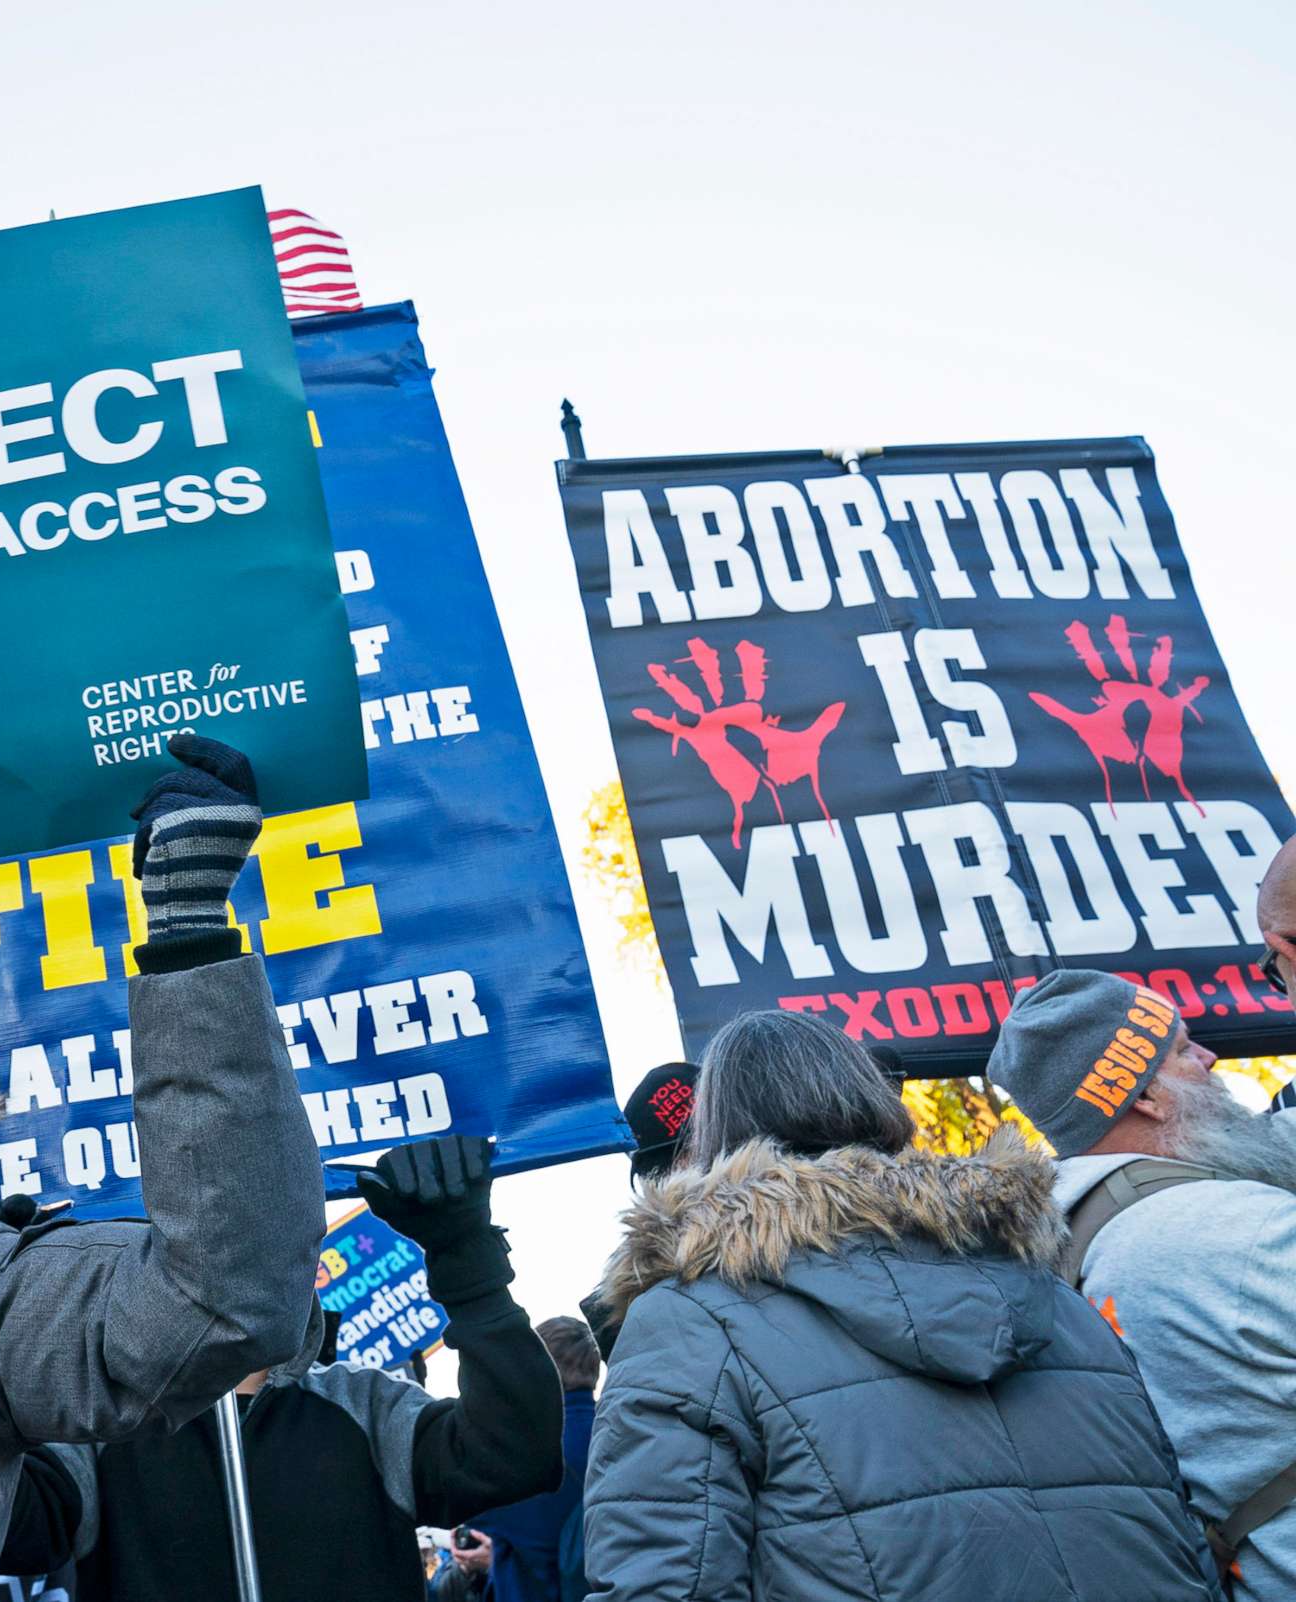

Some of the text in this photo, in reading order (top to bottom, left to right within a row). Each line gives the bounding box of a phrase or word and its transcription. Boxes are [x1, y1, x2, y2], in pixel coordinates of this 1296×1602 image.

[601, 467, 1176, 628] ABORTION
[82, 663, 240, 709] CENTER for
[88, 680, 307, 738] REPRODUCTIVE
[857, 628, 1018, 775] IS
[276, 970, 489, 1070] EVER
[648, 1077, 681, 1106] YOU
[655, 1085, 693, 1124] NEED
[1075, 1027, 1157, 1117] JESUS
[321, 1239, 416, 1312] mocrat
[336, 1269, 432, 1351] anding
[387, 1306, 441, 1348] life
